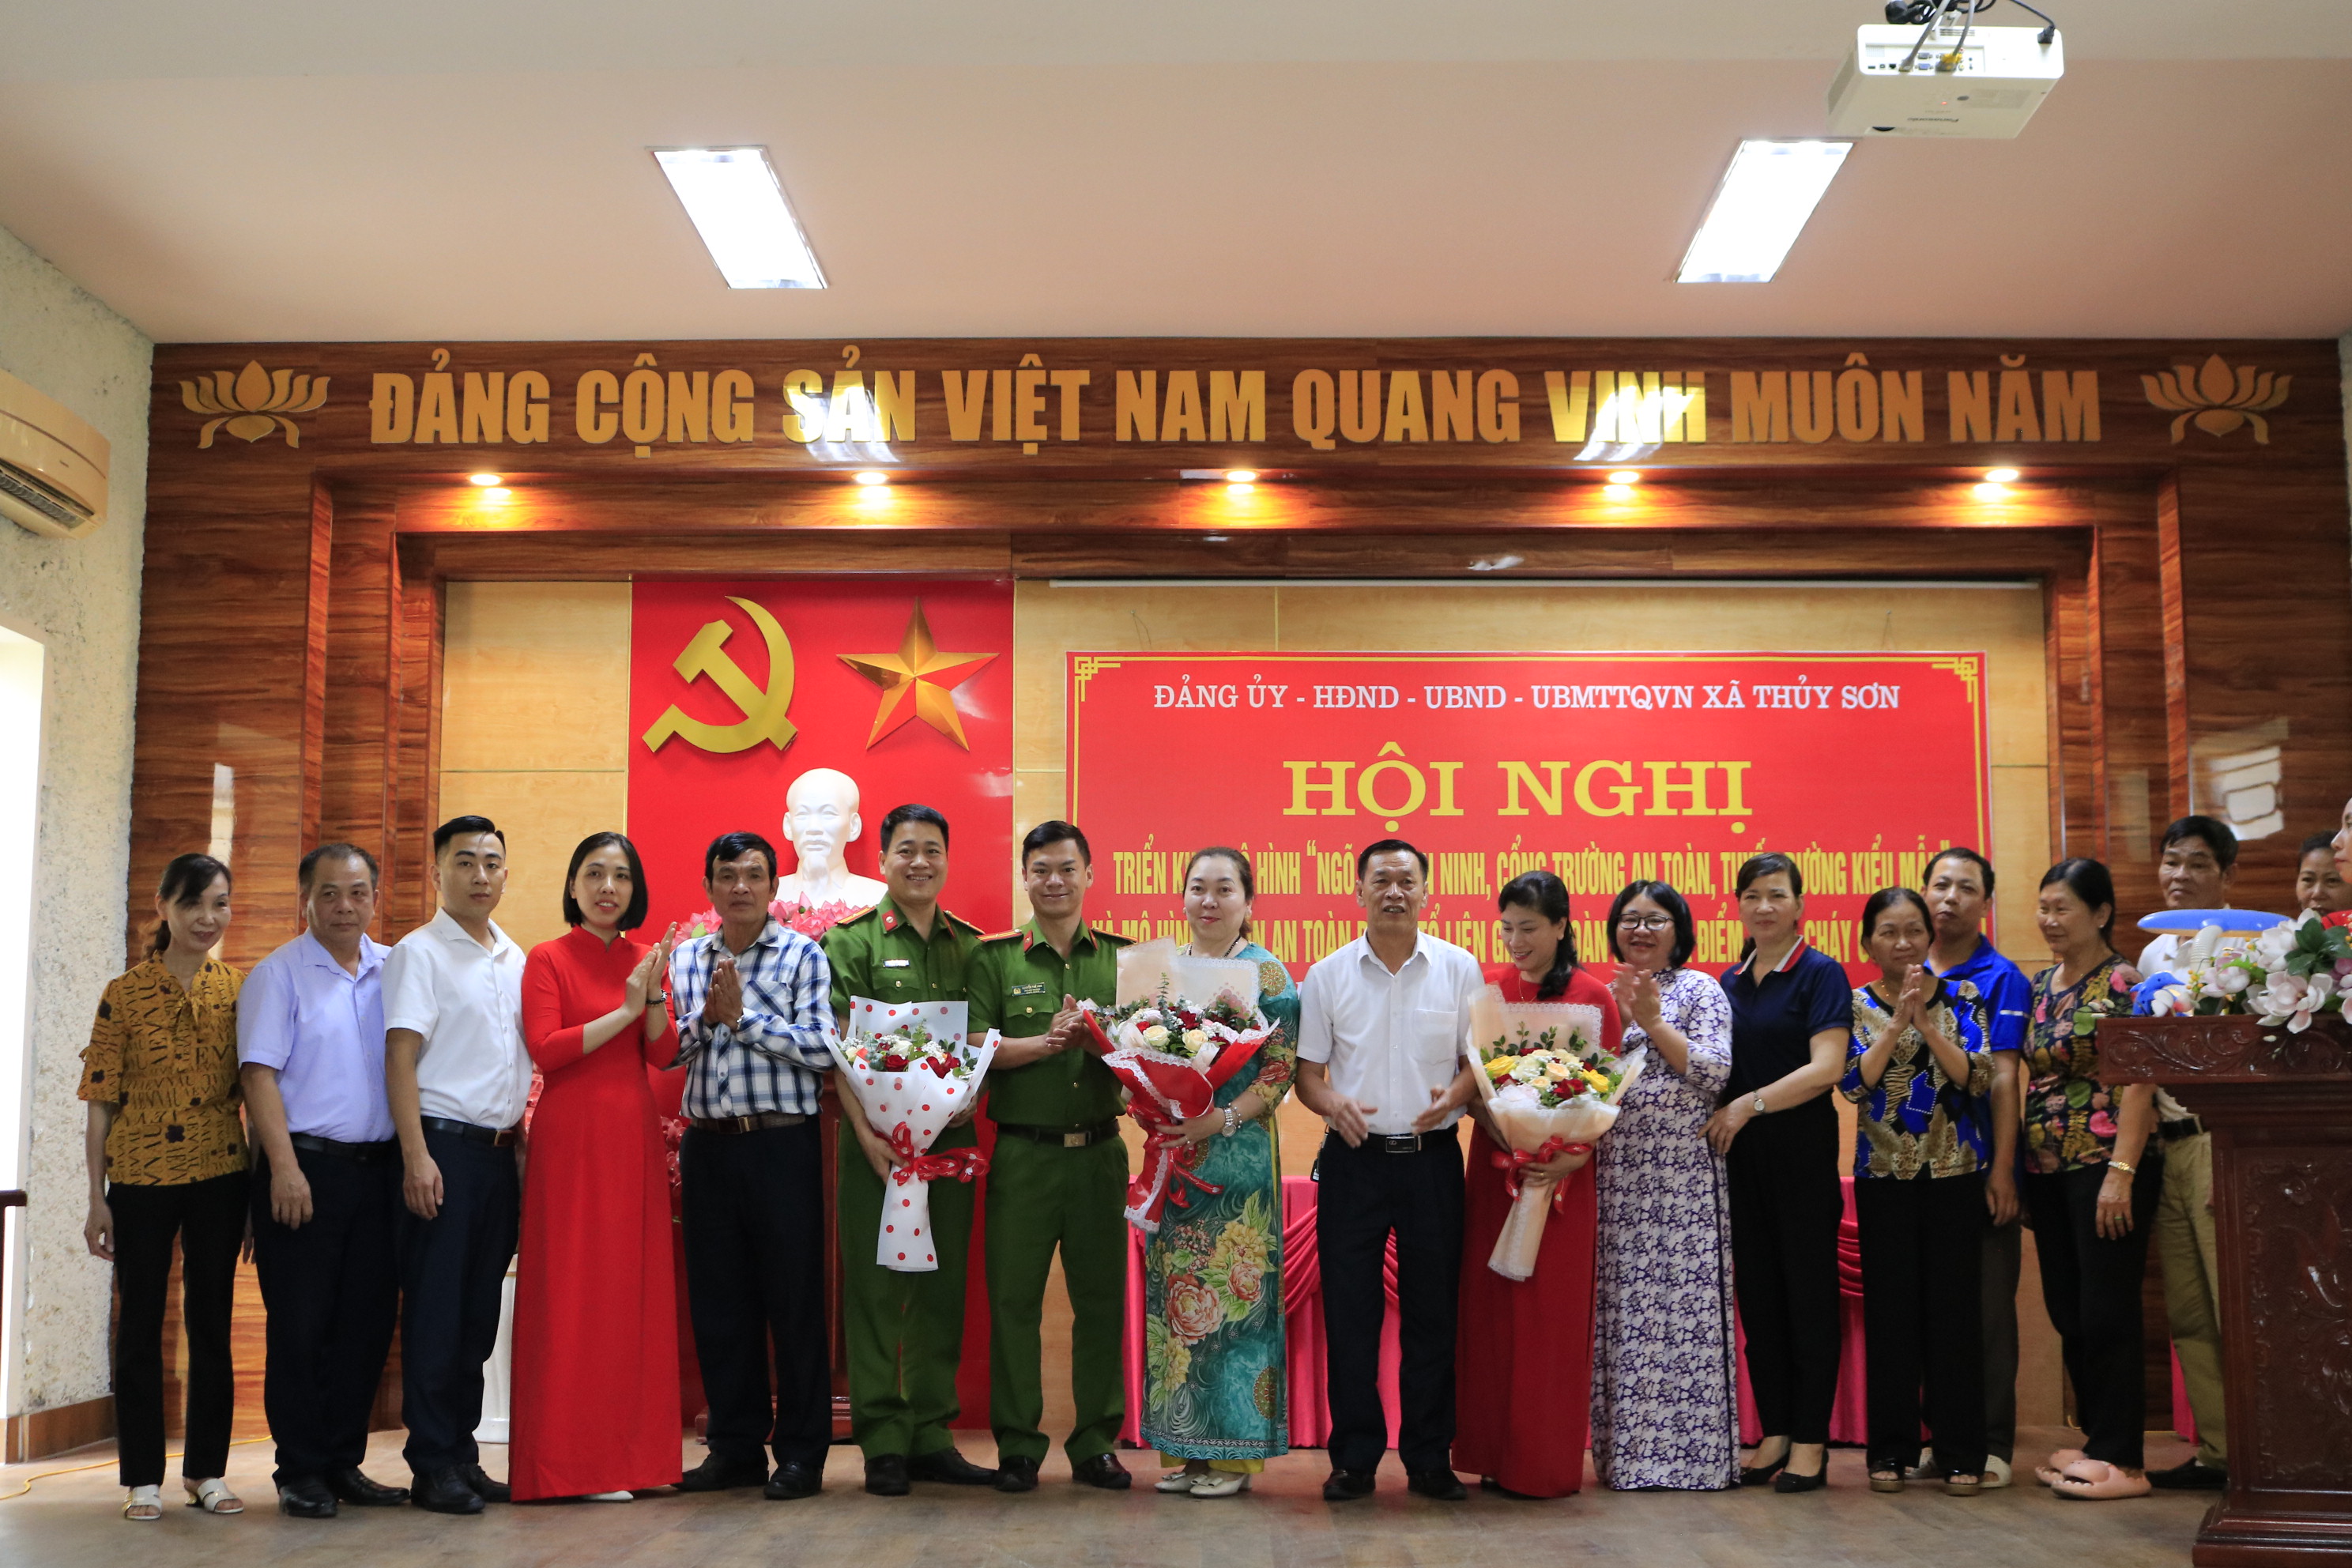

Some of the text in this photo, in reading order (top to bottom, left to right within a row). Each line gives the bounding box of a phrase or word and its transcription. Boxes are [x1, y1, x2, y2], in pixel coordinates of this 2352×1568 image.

[369, 345, 2101, 458] ĐẢNG CỘNG SẢN VIỆT NAM QUANG VINH MUÔN NĂM
[1154, 674, 1238, 708] ĐẢNG
[1246, 674, 1288, 708] ỦY
[1314, 685, 1400, 708] HĐND
[1424, 685, 1506, 709] UBND
[1531, 684, 1694, 710] UBMTTQVN
[1702, 680, 1745, 709] XÃ
[1753, 674, 1833, 709] THỦY
[1841, 681, 1901, 709] SƠN
[1283, 741, 1752, 834] HỘI NGHỊ
[1113, 834, 1167, 895] TRIỂN
[1257, 842, 1300, 895] HÌNH
[1440, 852, 1491, 900] NINH,
[1552, 841, 1625, 895] TRƯỜNG
[1631, 852, 1657, 883] AN
[1661, 842, 1716, 900] TOÀN,
[1852, 834, 1894, 895] KIỂU
[1272, 920, 1297, 963] AN
[1302, 910, 1351, 963] TOÀN
[1697, 902, 1743, 963] ĐIỂM
[1804, 911, 1852, 963] CHÁY
